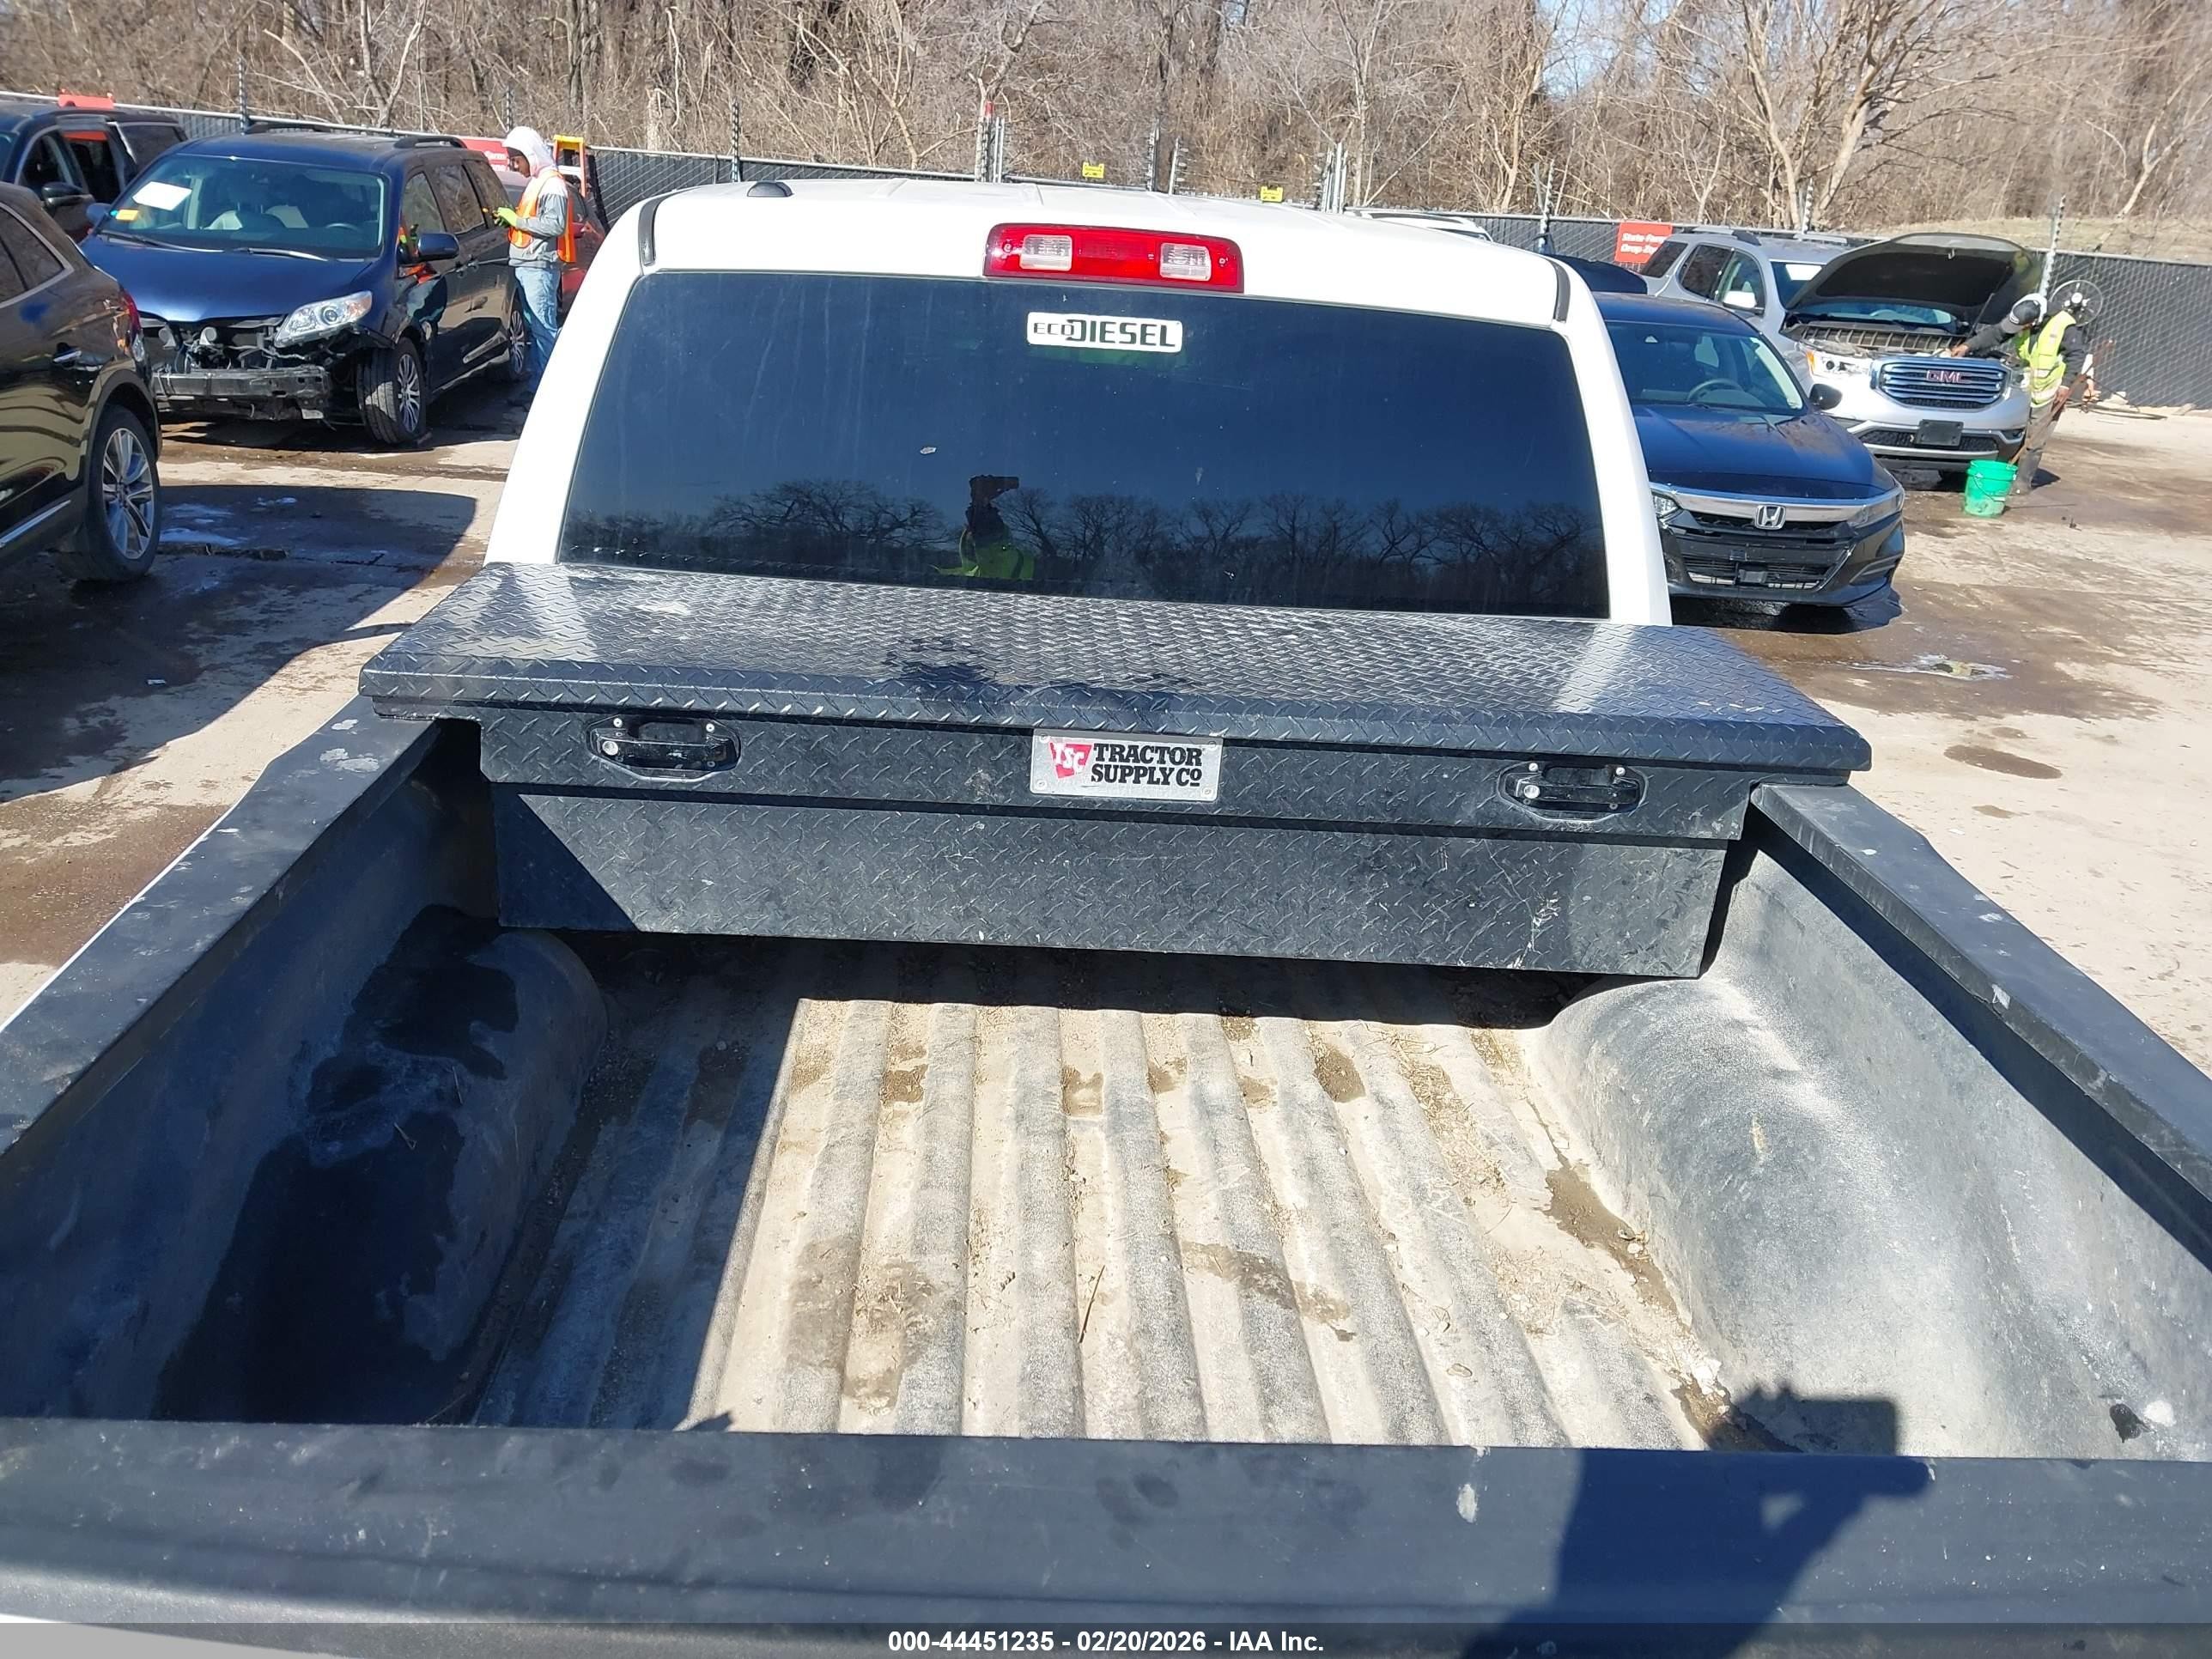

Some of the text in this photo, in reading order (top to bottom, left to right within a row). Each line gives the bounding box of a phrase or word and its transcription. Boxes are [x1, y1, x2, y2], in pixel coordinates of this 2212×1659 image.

[1925, 369, 1972, 384] GMC
[1054, 744, 1086, 774] TSC
[1093, 743, 1203, 767] TRACTOR
[1091, 764, 1176, 787] SUPPLY
